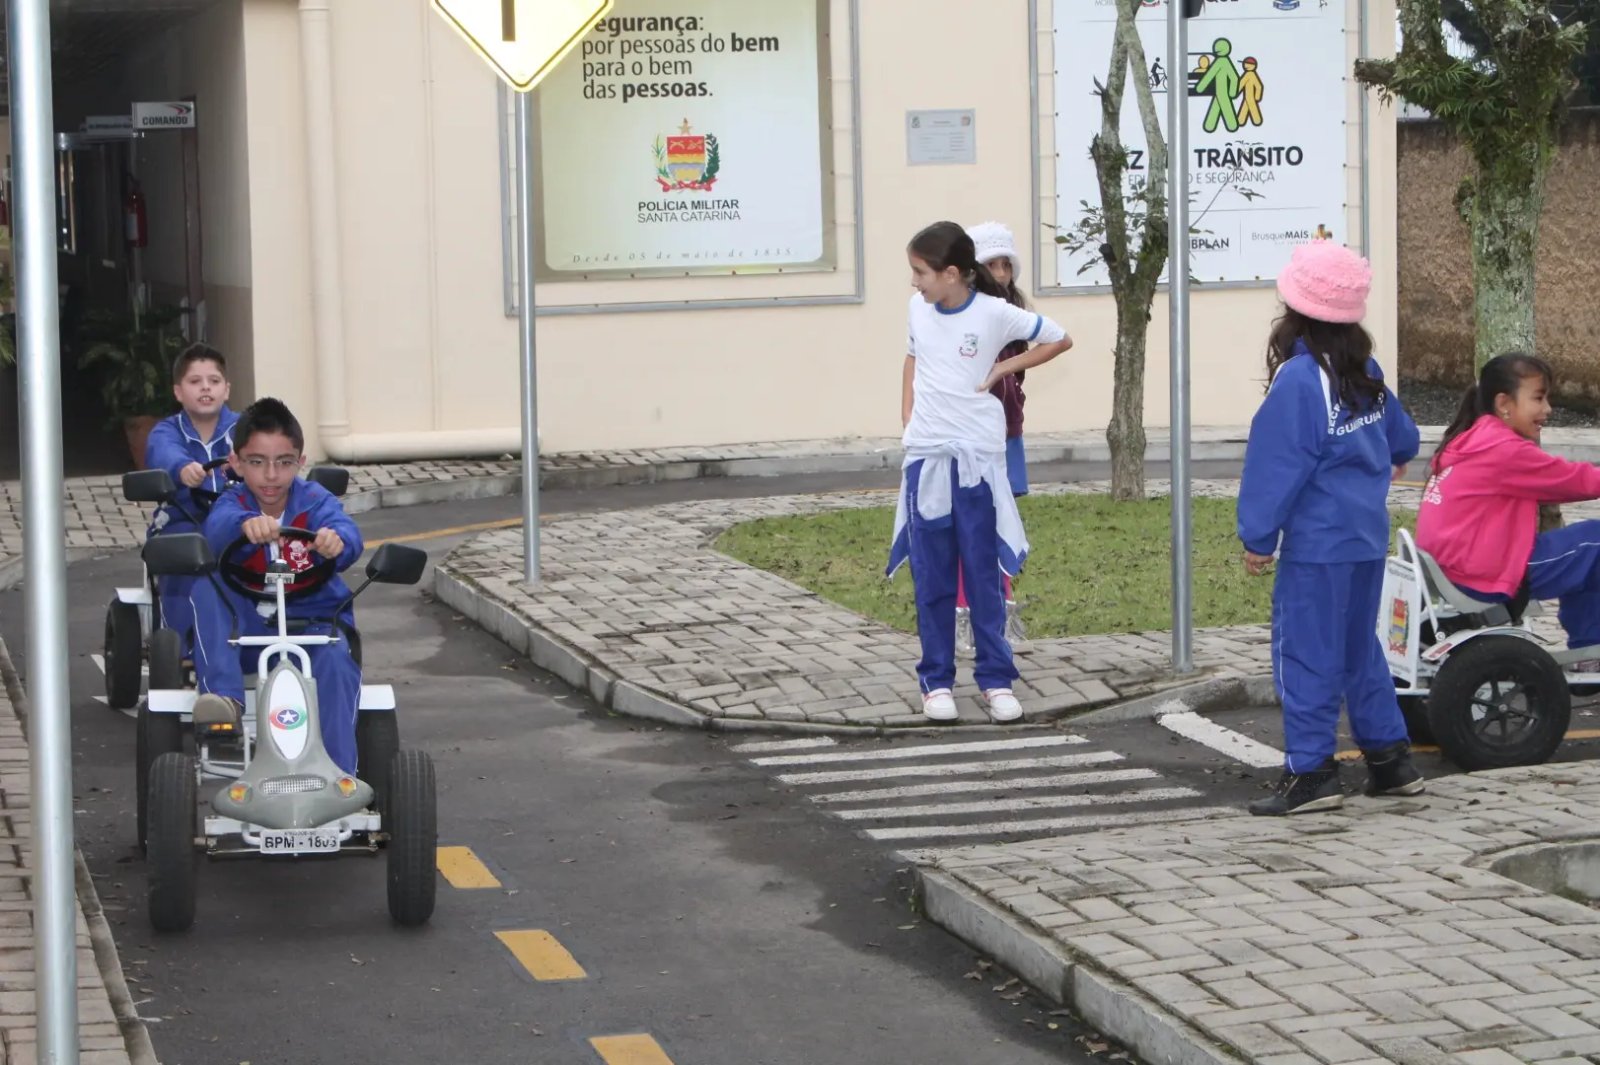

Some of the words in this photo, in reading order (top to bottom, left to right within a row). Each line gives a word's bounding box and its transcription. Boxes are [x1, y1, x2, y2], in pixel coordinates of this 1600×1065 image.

[594, 15, 704, 37] egurança:
[582, 39, 615, 60] por
[620, 38, 696, 59] pessoas
[701, 32, 725, 53] do
[731, 32, 780, 52] bem
[583, 60, 625, 82] para
[631, 61, 643, 76] o
[649, 55, 693, 76] bem
[583, 79, 617, 99] das
[622, 81, 713, 103] pessoas.
[142, 116, 188, 125] COMANDO
[1194, 143, 1303, 168] TRÂNSITO
[1196, 173, 1201, 184] E
[1205, 171, 1275, 184] SEGURANÇA
[638, 199, 688, 211] POLÍCIA
[691, 199, 739, 210] MILITAR
[637, 212, 678, 223] SANTA
[680, 210, 741, 222] CATARINA
[264, 836, 294, 848] BPM
